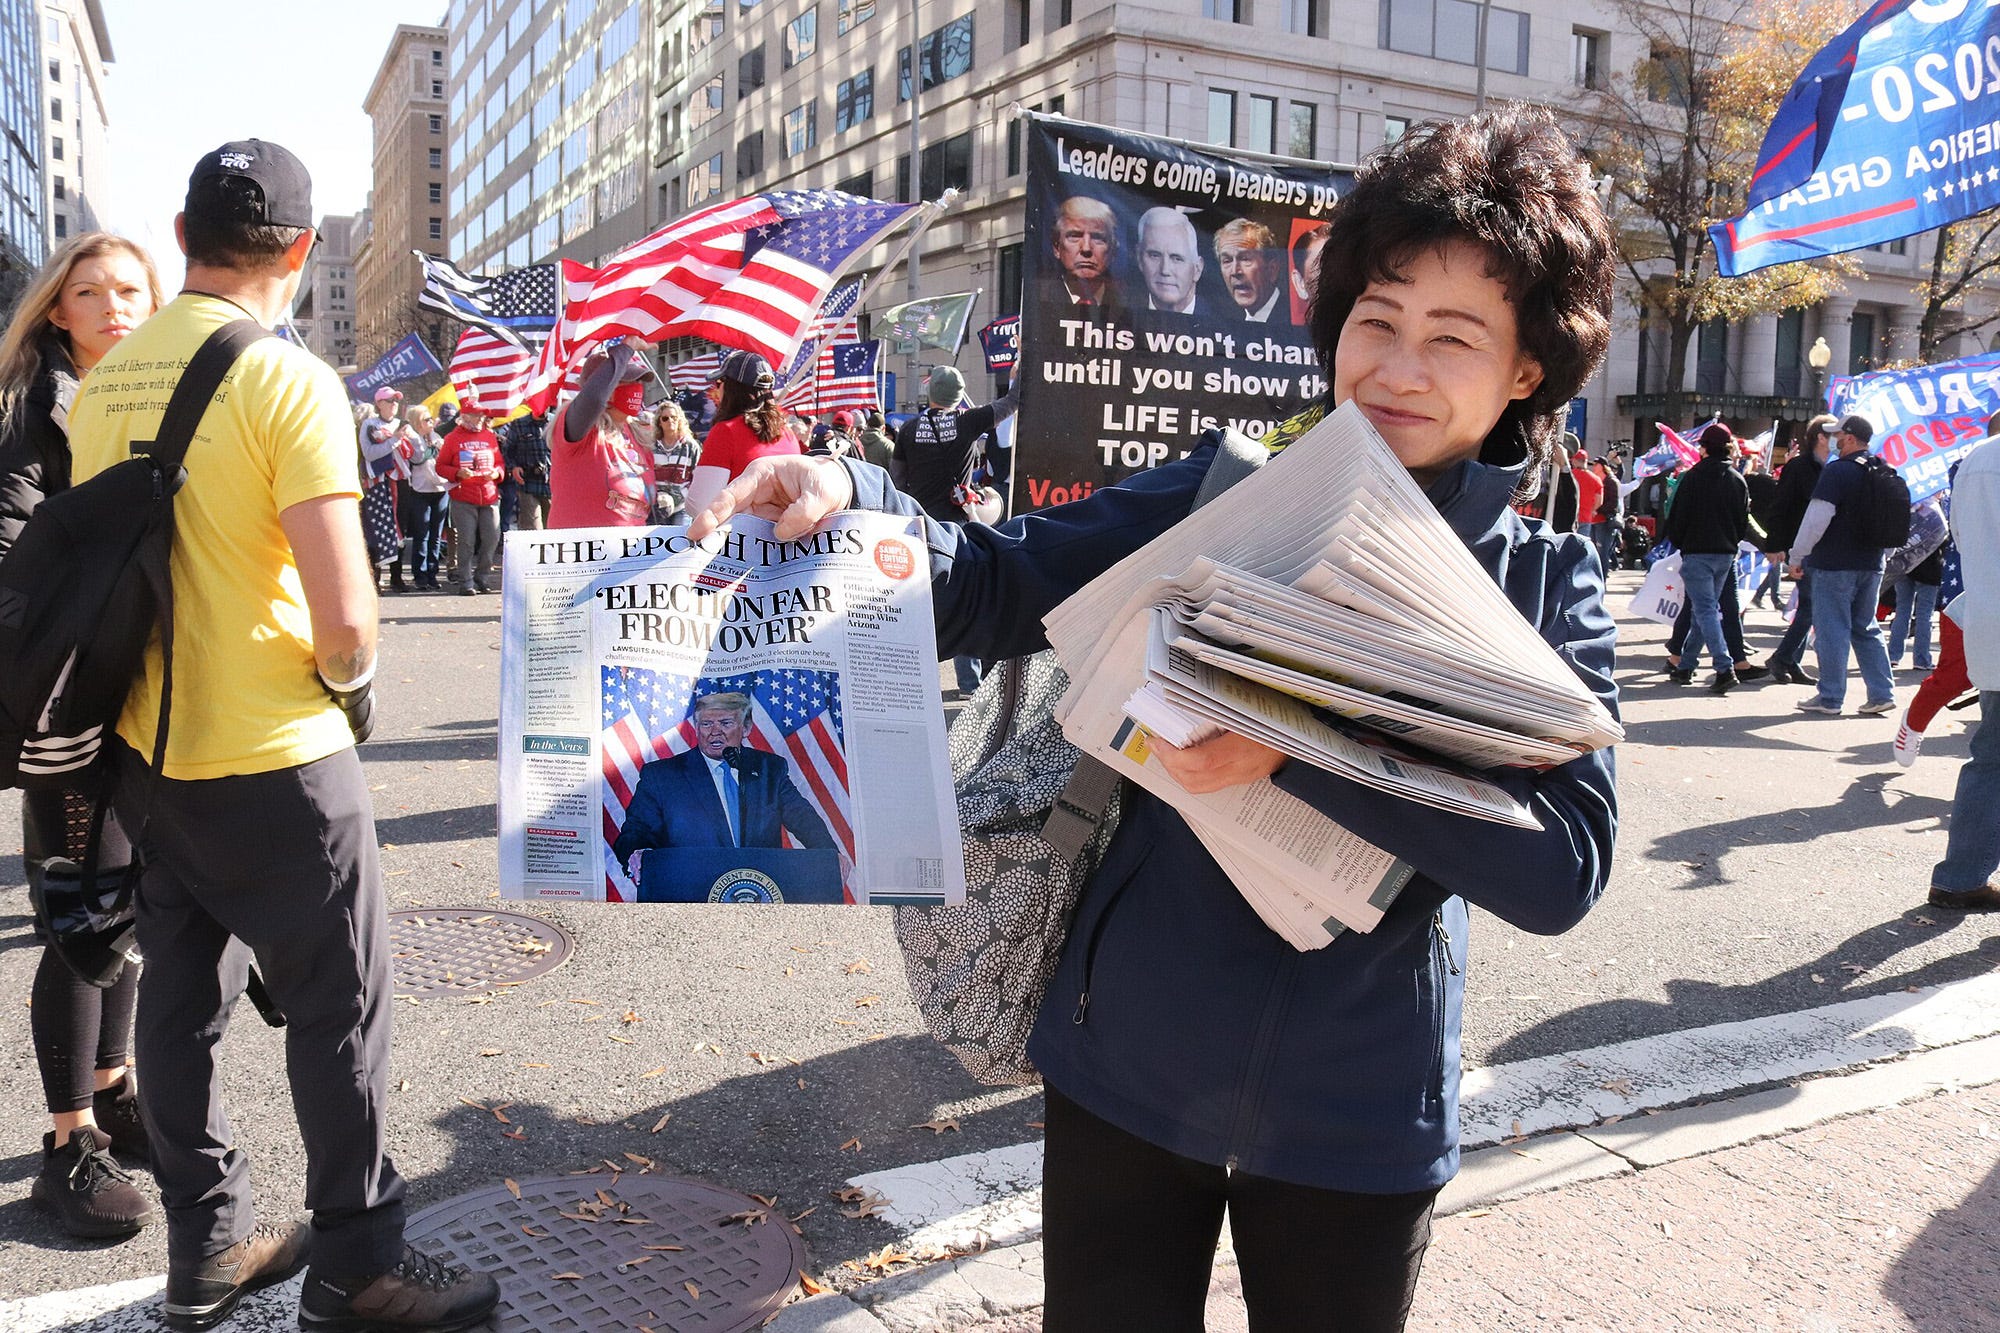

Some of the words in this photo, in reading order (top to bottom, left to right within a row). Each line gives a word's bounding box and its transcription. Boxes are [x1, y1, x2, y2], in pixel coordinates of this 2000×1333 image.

[1057, 137, 1147, 185] Leaders
[1154, 161, 1221, 203] come,
[1227, 165, 1307, 207] leaders
[1309, 184, 1339, 216] go
[1059, 319, 1134, 351] This
[1145, 331, 1236, 360] won't
[1043, 358, 1121, 386] until
[1131, 365, 1193, 395] you
[1203, 366, 1290, 397] show
[120, 383, 131, 392] to
[214, 391, 228, 404] of
[1102, 402, 1179, 435] LIFE
[1190, 409, 1219, 435] is
[1097, 439, 1169, 468] TOP
[530, 539, 608, 565] THE
[755, 529, 864, 567] TIMES
[542, 593, 575, 602] General
[843, 583, 875, 593] Official
[876, 588, 895, 597] Says
[770, 585, 836, 617] FAR
[844, 592, 887, 604] Optimism
[845, 601, 882, 613] Growing
[882, 605, 902, 614] That
[1656, 599, 1680, 619] NO
[846, 610, 875, 621] Trump
[876, 613, 898, 622] Wins
[618, 612, 714, 652] FROM
[847, 619, 880, 630] Arizona
[612, 645, 650, 654] LAWSUITS
[706, 657, 730, 665] Results
[731, 656, 739, 664] of
[739, 654, 750, 662] the
[812, 649, 830, 658] being
[704, 665, 731, 673] election
[732, 659, 775, 671] irregularities
[798, 658, 819, 666] swing
[530, 739, 540, 749] In
[541, 740, 557, 750] the
[559, 740, 584, 752] News
[711, 871, 744, 903] RESIDENT
